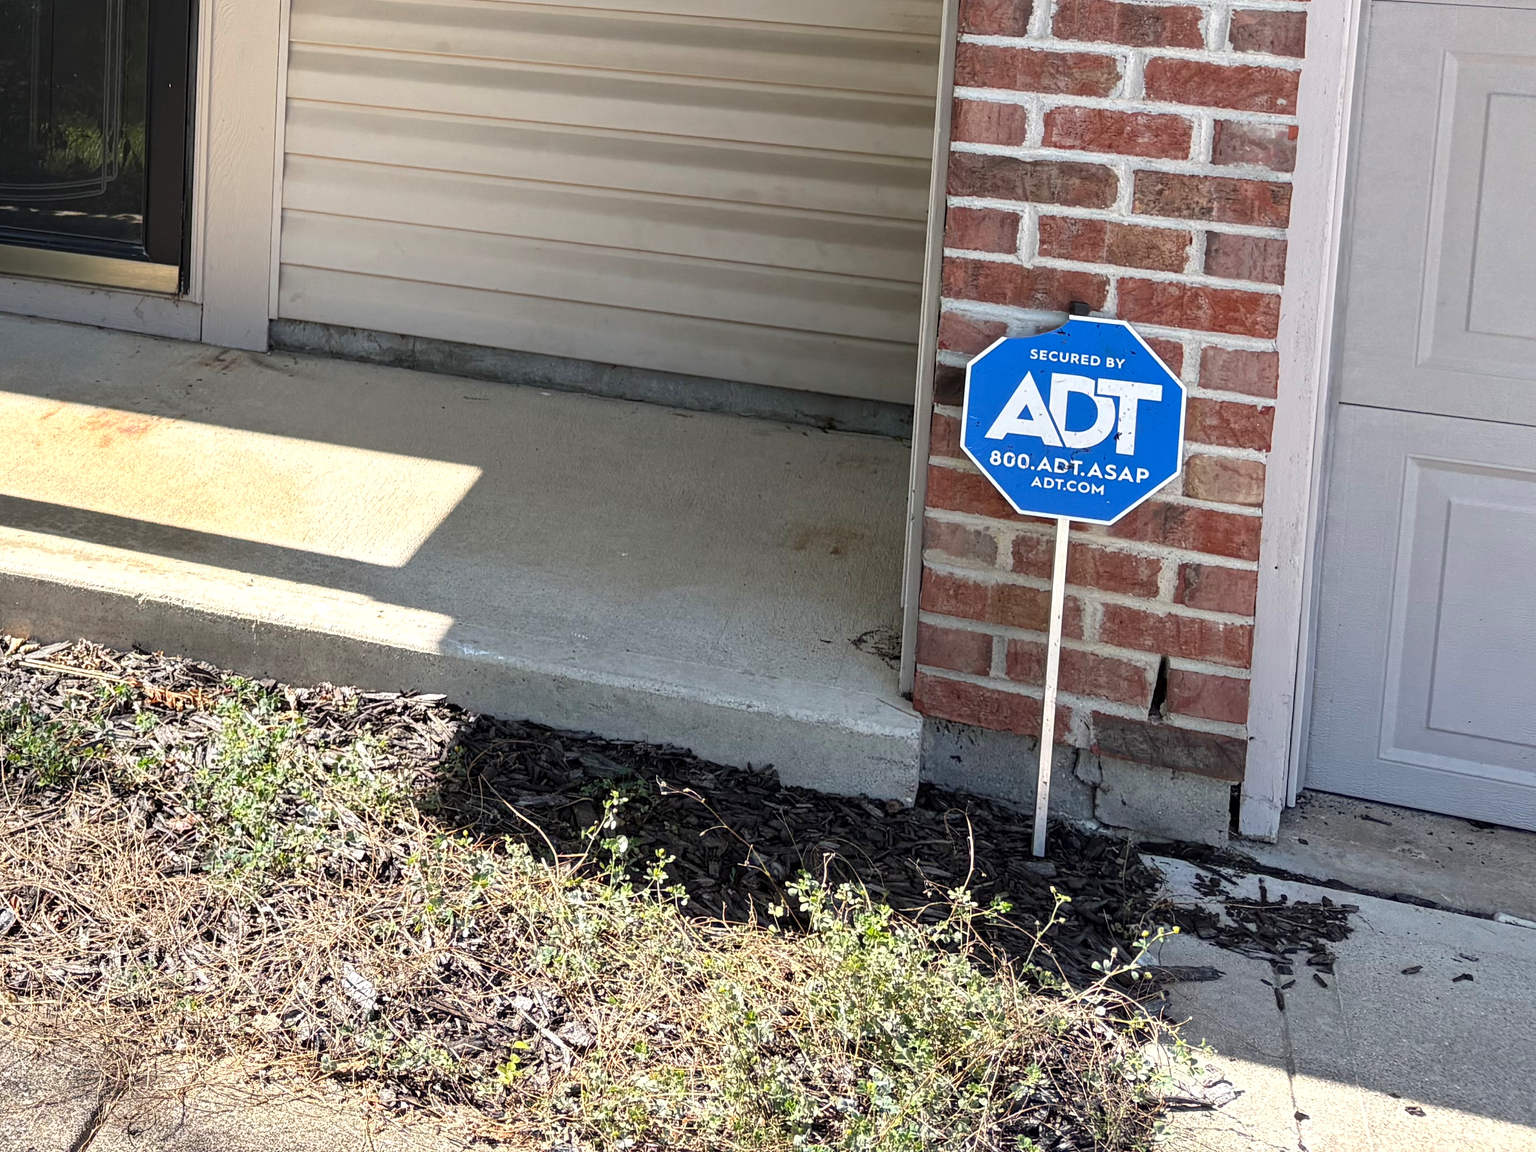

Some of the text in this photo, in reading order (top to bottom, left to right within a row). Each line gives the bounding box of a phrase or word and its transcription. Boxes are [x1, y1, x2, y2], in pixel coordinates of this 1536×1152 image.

[1030, 349, 1125, 369] SECURED BY
[984, 370, 1163, 456] ADT
[989, 450, 1150, 484] 800.ADT.ASAP
[1030, 476, 1105, 496] ADT.COM
